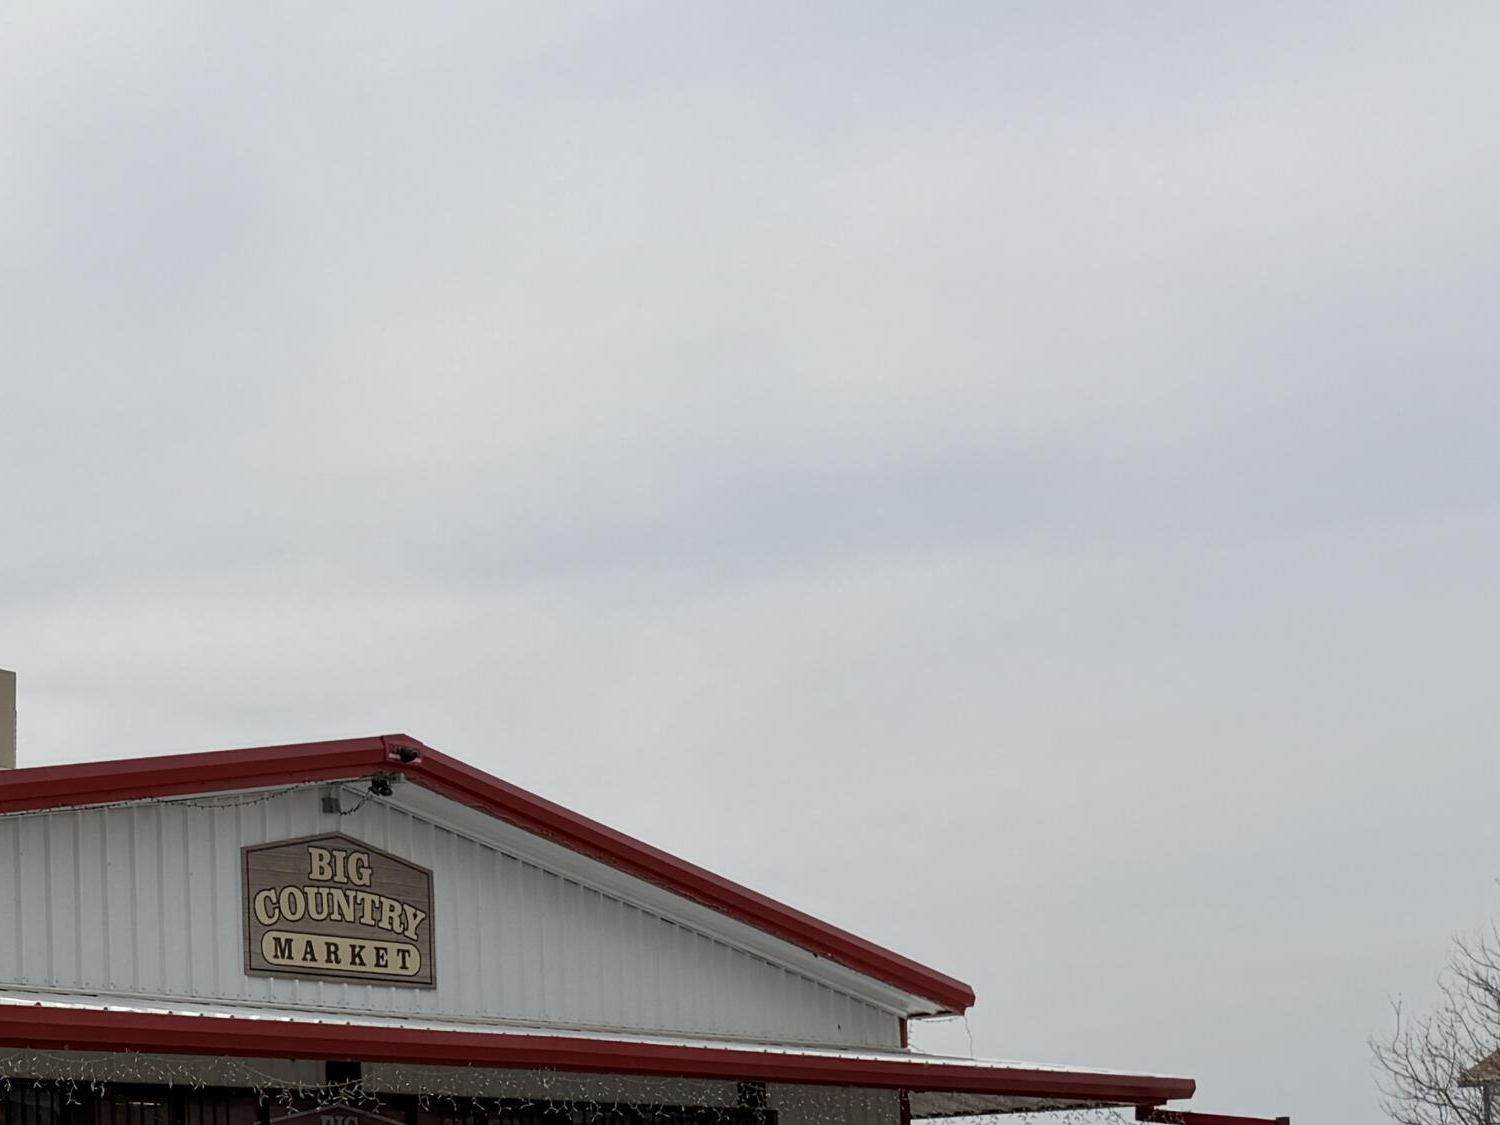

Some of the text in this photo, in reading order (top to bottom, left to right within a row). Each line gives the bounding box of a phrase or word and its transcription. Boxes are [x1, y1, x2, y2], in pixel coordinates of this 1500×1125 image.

[307, 846, 373, 887] BIG
[253, 885, 427, 941] COUNTRY
[272, 936, 412, 970] MARKET
